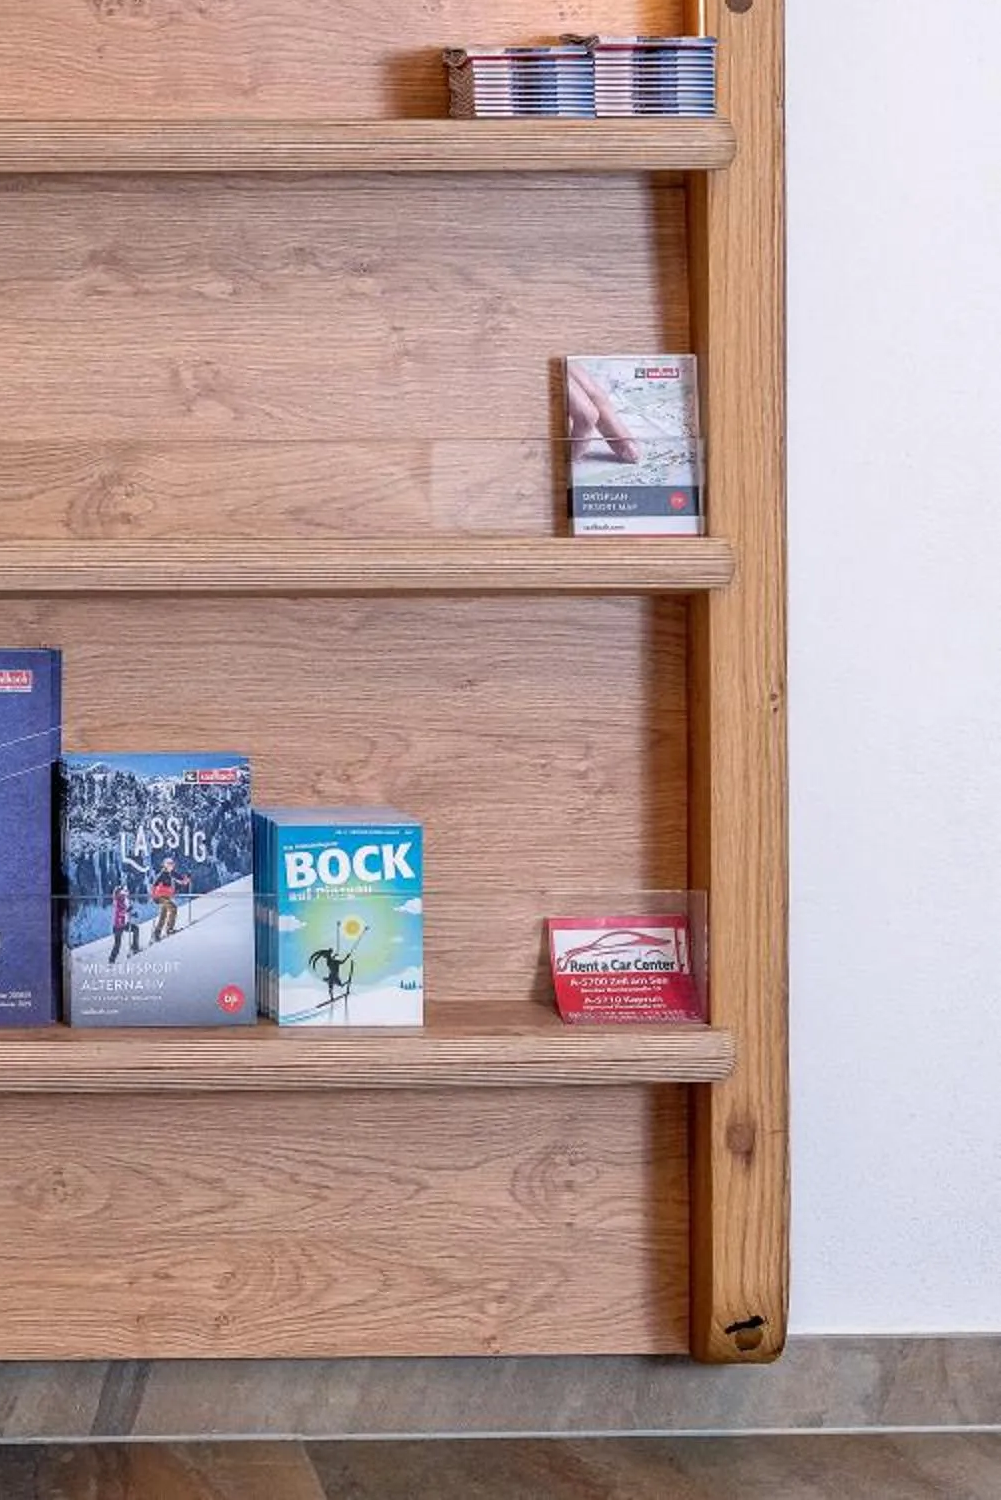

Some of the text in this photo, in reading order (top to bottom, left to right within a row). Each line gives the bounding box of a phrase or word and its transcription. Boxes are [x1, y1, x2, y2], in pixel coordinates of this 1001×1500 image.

[284, 842, 416, 889] BOCK
[570, 959, 676, 972] Rent a Car Center
[81, 979, 166, 991] ALTERNAV
